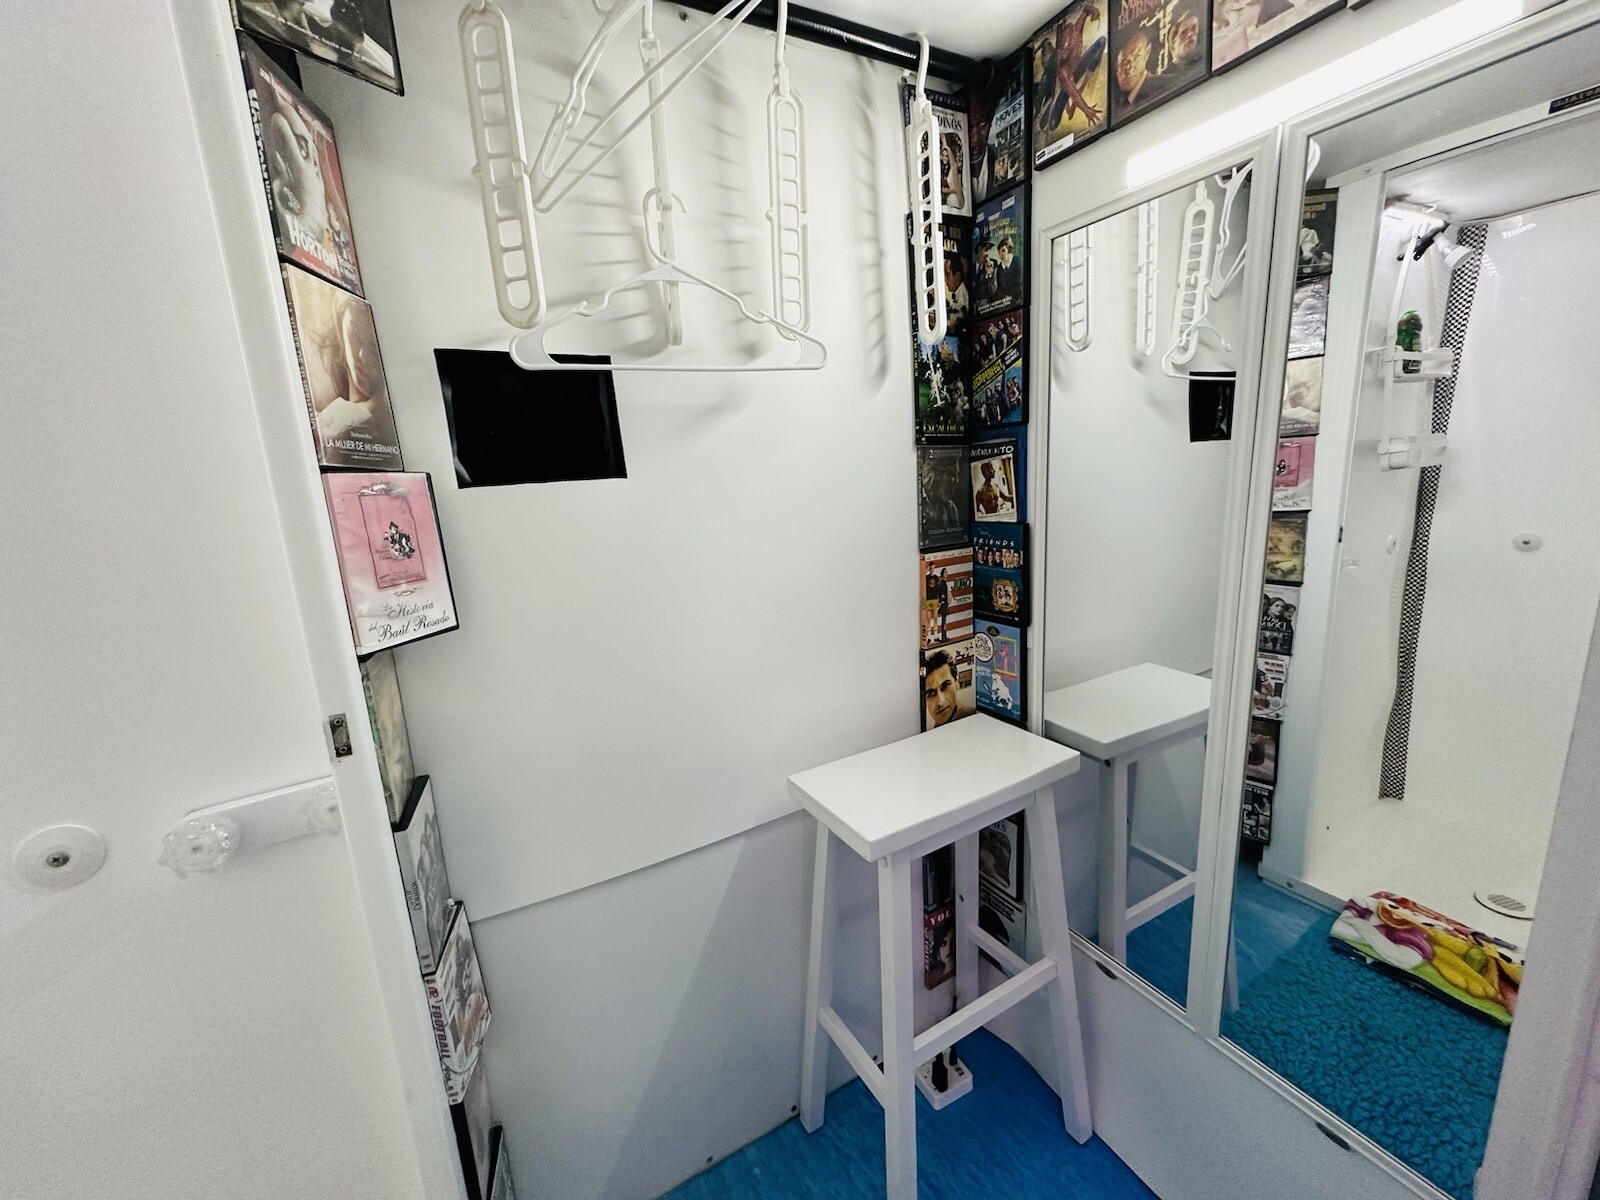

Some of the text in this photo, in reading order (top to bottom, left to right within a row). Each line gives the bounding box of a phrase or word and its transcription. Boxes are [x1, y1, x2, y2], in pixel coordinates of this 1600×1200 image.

[995, 101, 1022, 124] MOVIES
[937, 115, 963, 132] DINGS
[287, 214, 341, 277] HORTON
[325, 438, 335, 448] LA
[335, 439, 355, 450] MUJER
[355, 441, 364, 451] DE
[364, 443, 371, 451] MI
[371, 443, 400, 455] HERMANO
[973, 536, 1014, 547] FRIENDS
[387, 600, 434, 620] Historia
[378, 619, 411, 642] Baúl
[413, 610, 450, 632] Rosado
[431, 1004, 451, 1059] FOOTBALL
